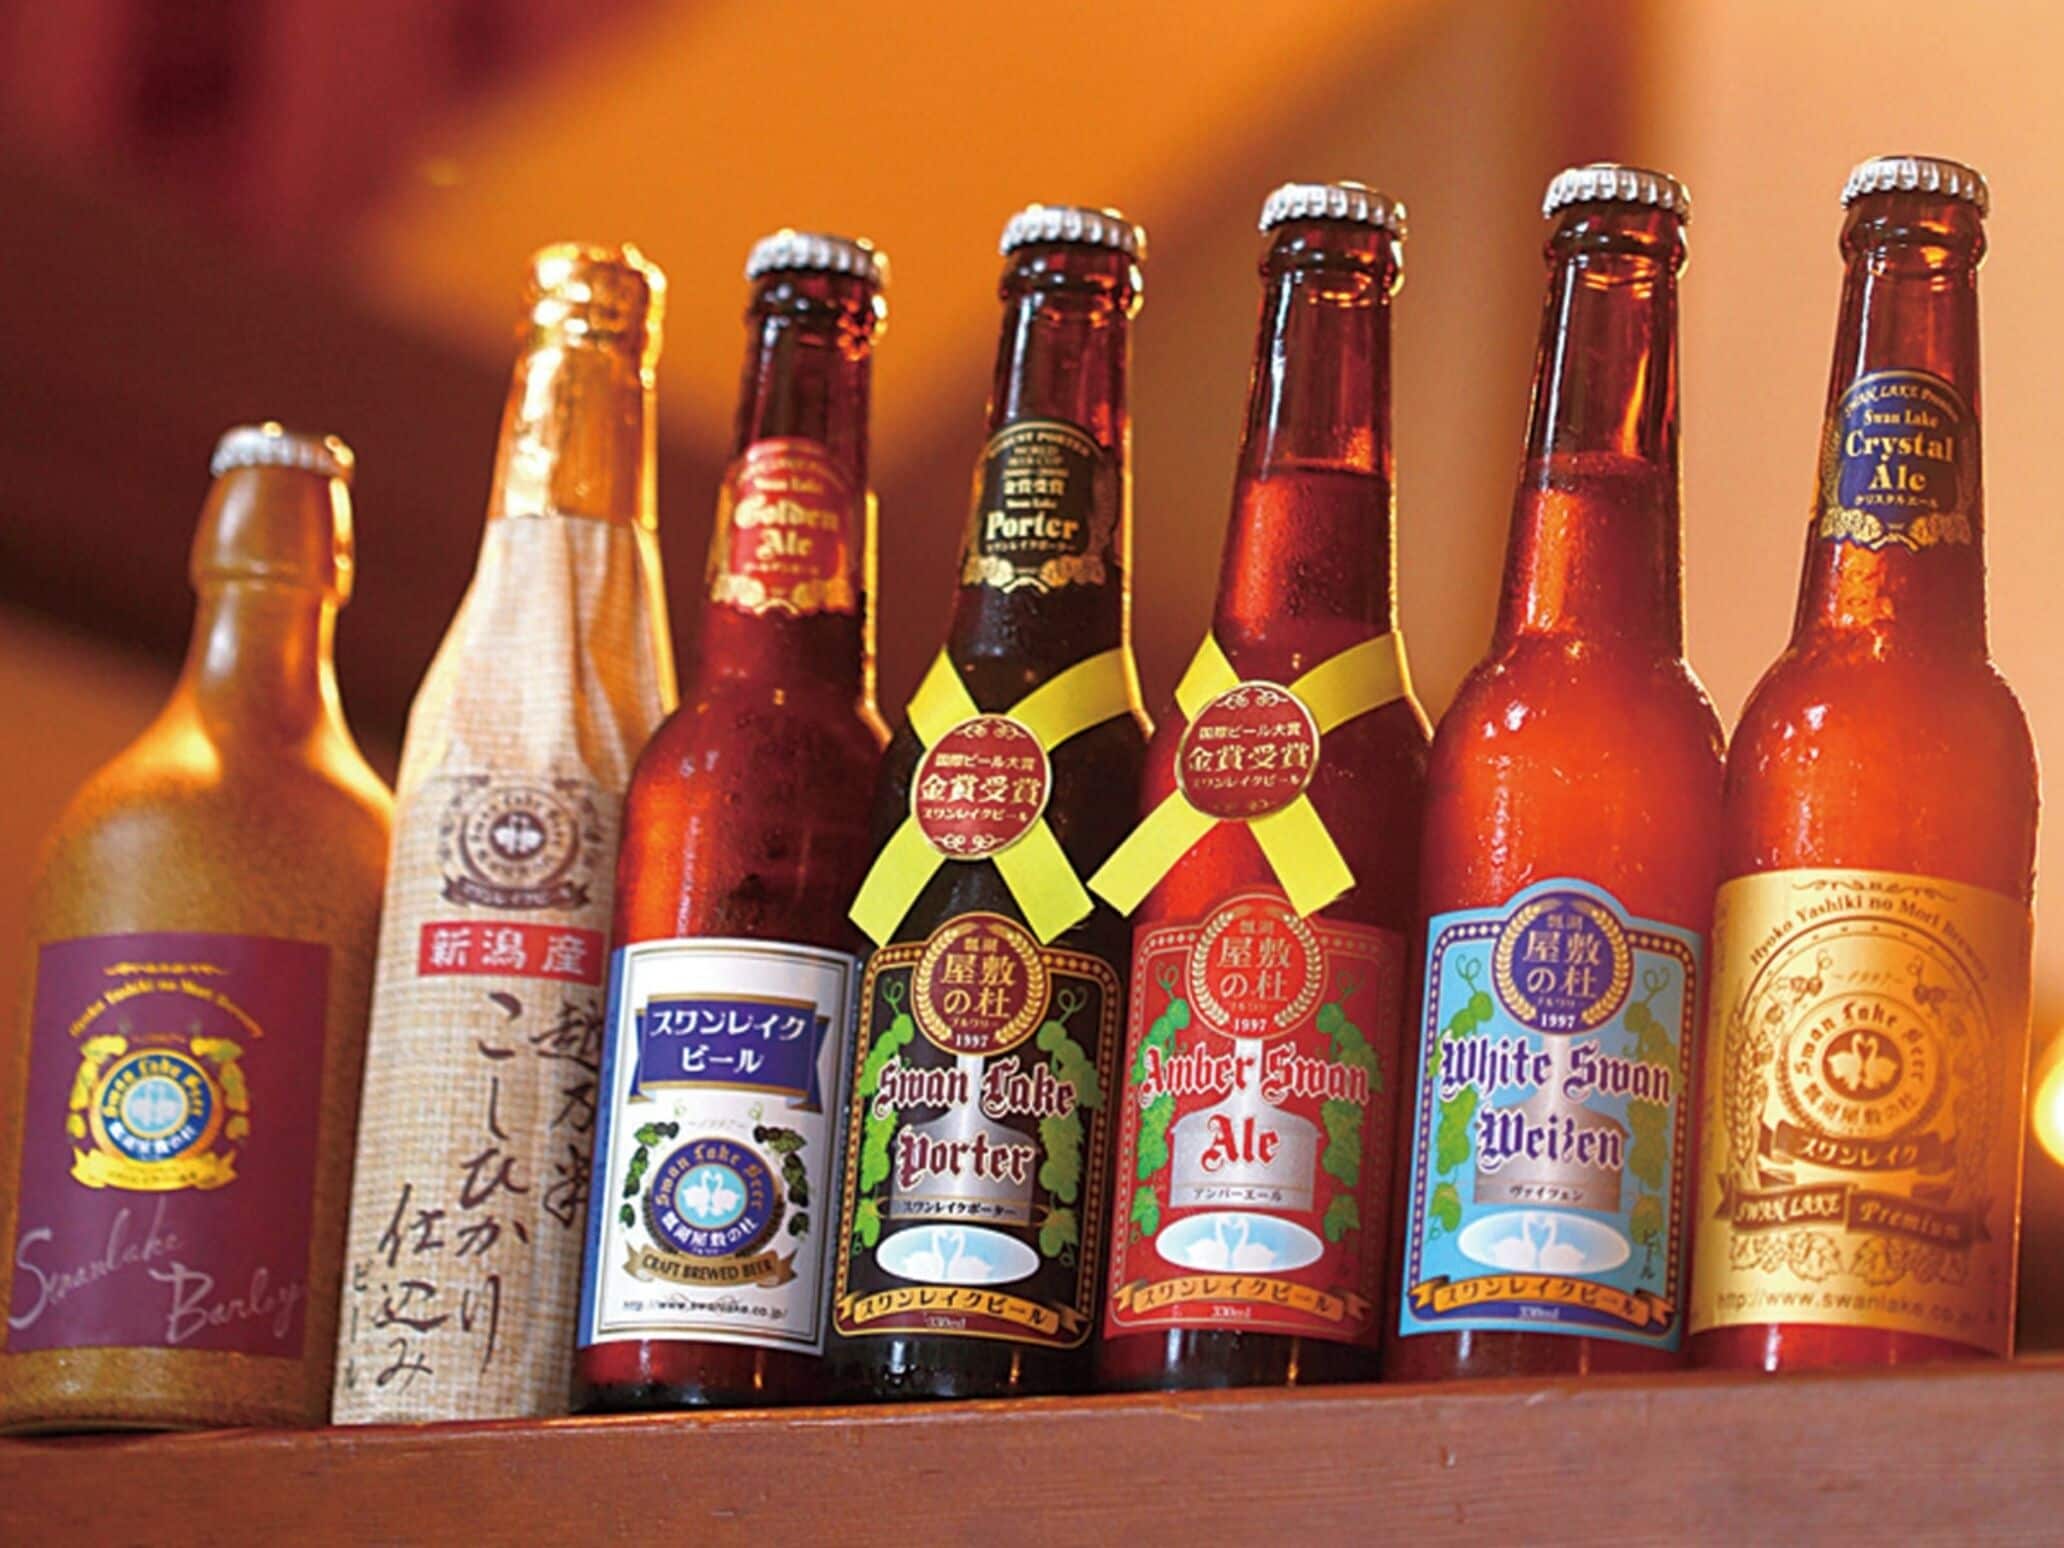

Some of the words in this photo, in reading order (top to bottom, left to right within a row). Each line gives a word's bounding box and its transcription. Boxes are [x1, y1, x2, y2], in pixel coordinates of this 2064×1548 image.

[1863, 408, 1901, 426] Swan
[1904, 409, 1940, 429] Lake
[1845, 429, 1953, 461] Crystal
[1868, 463, 1927, 492] Ale
[985, 511, 1080, 542] Porter
[756, 528, 813, 559] Ale
[1796, 895, 1864, 922] Yashiki
[1869, 898, 1893, 911] no
[1900, 899, 1940, 928] Mori
[428, 927, 588, 978] 新潟産
[1216, 936, 1291, 968] 屋敷
[1521, 930, 1601, 967] 屋敷
[940, 953, 1018, 986] 屋敷
[1220, 969, 1289, 1001] の杜
[1526, 965, 1598, 998] の杜
[943, 986, 1011, 1018] の杜
[650, 1008, 806, 1041] スワンレイク
[1234, 1018, 1268, 1032] 1997
[1541, 1013, 1577, 1029] 1997
[682, 1044, 765, 1074] ビール
[1137, 1042, 1256, 1109] Amber
[1260, 1040, 1372, 1105] Swan
[1438, 1031, 1553, 1100] White
[1562, 1038, 1674, 1107] Swan
[872, 1054, 970, 1121] Swan
[981, 1055, 1078, 1119] Lake
[1201, 1112, 1281, 1175] Ale
[1477, 1105, 1627, 1173] Weizen
[1803, 1138, 1919, 1168] スワンレイク
[896, 1124, 1035, 1191] Porter
[457, 991, 530, 1374] こしひかり
[655, 1157, 691, 1208] Swan
[693, 1143, 742, 1166] Lake
[903, 1200, 1016, 1217] スワンレイクポーター
[7, 1194, 181, 1330] Swanlake
[641, 1253, 681, 1276] CRAFT
[682, 1263, 739, 1281] BREWED
[742, 1258, 773, 1279] BEER
[147, 1260, 304, 1344] Barley
[372, 1183, 449, 1393] 仕込み
[1144, 1278, 1335, 1313] スワンレイクビール
[1442, 1278, 1638, 1315] スワンレイクビール
[861, 1289, 1048, 1324] スワンレイクビール
